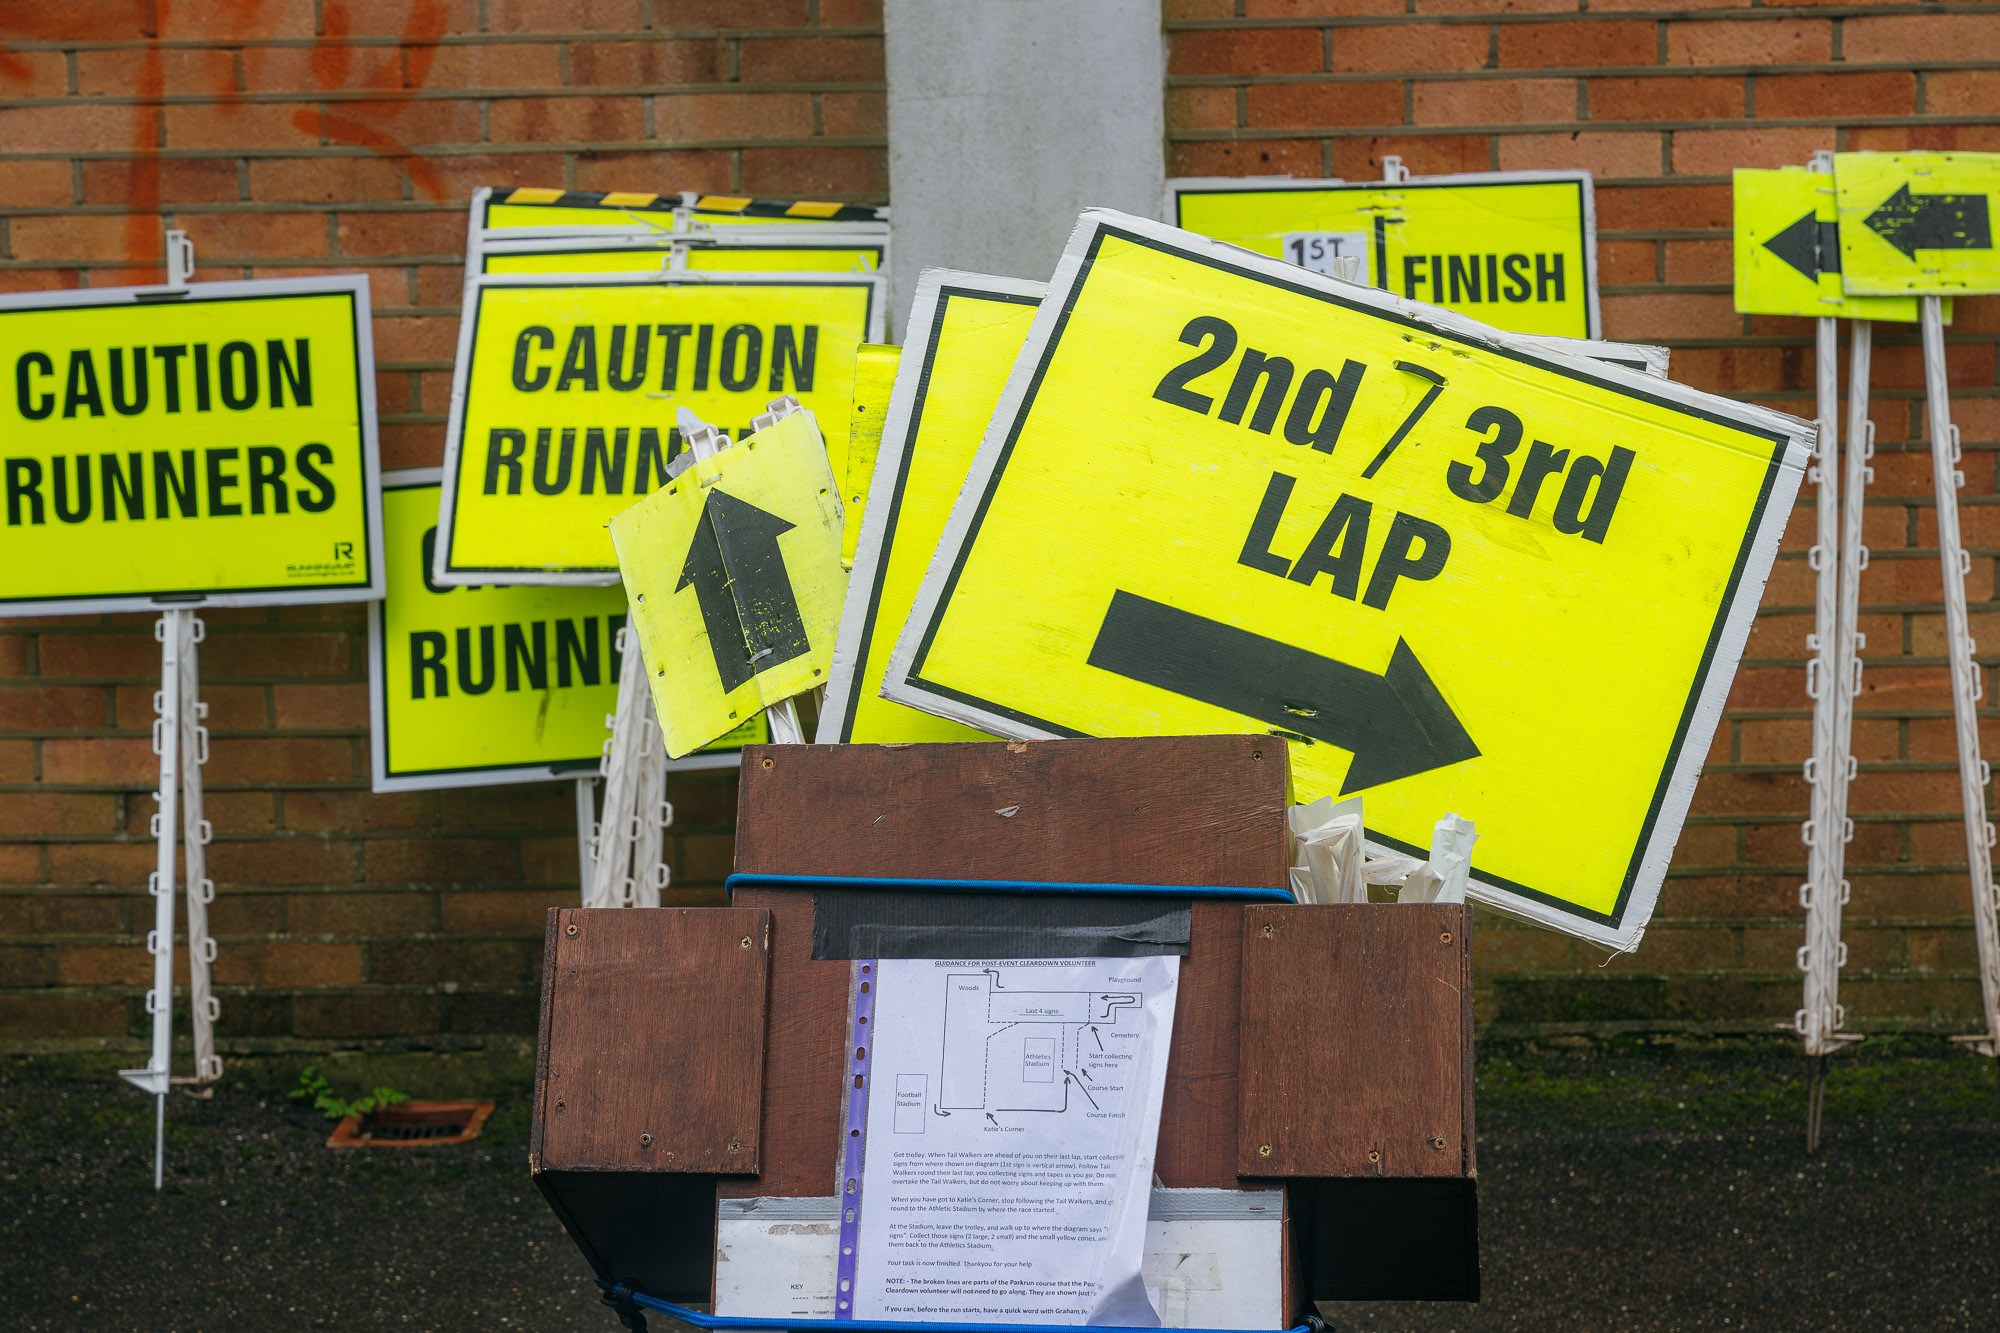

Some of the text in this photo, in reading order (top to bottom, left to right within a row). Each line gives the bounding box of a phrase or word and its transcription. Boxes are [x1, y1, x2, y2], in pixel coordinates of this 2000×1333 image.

[1290, 238, 1344, 267] 1ST
[1402, 252, 1567, 304] FINISH
[511, 323, 819, 393] CAUTION
[15, 337, 314, 422] CAUTION
[1152, 315, 1637, 545] 2nd / 3rd
[4, 442, 338, 528] RUNNERS
[1236, 471, 1452, 611] LAP
[1108, 976, 1142, 984] Playground
[1044, 1007, 1059, 1016] signs
[1110, 1032, 1140, 1040] Cemetery
[1104, 1053, 1133, 1061] collecting
[1025, 1059, 1050, 1067] Stadium
[1088, 1061, 1118, 1069] signs here
[1109, 1084, 1124, 1092] Start
[1108, 1111, 1126, 1119] Finish
[958, 1151, 983, 1159] Walkers
[1043, 1152, 1058, 1160] their
[893, 1160, 908, 1168] signs
[974, 1160, 999, 1169] diagram
[1013, 1161, 1025, 1169] sign
[1032, 1161, 1055, 1169] vertical
[1078, 1162, 1099, 1170] Follow
[1039, 1179, 1063, 1188] keeping
[949, 1232, 964, 1241] signs
[1028, 1233, 1038, 1241] the
[1056, 1234, 1077, 1242] yellow
[888, 1240, 904, 1248] them
[939, 1241, 966, 1249] Athletics
[963, 1260, 993, 1268] Thankyou
[1018, 1260, 1033, 1269] help
[973, 1279, 989, 1287] parts
[950, 1287, 962, 1295] will
[1029, 1288, 1044, 1297] They
[1078, 1289, 1090, 1298] just
[917, 1305, 938, 1313] before
[983, 1306, 999, 1314] have
[1004, 1307, 1021, 1315] quick
[1055, 1307, 1080, 1315] Graham
